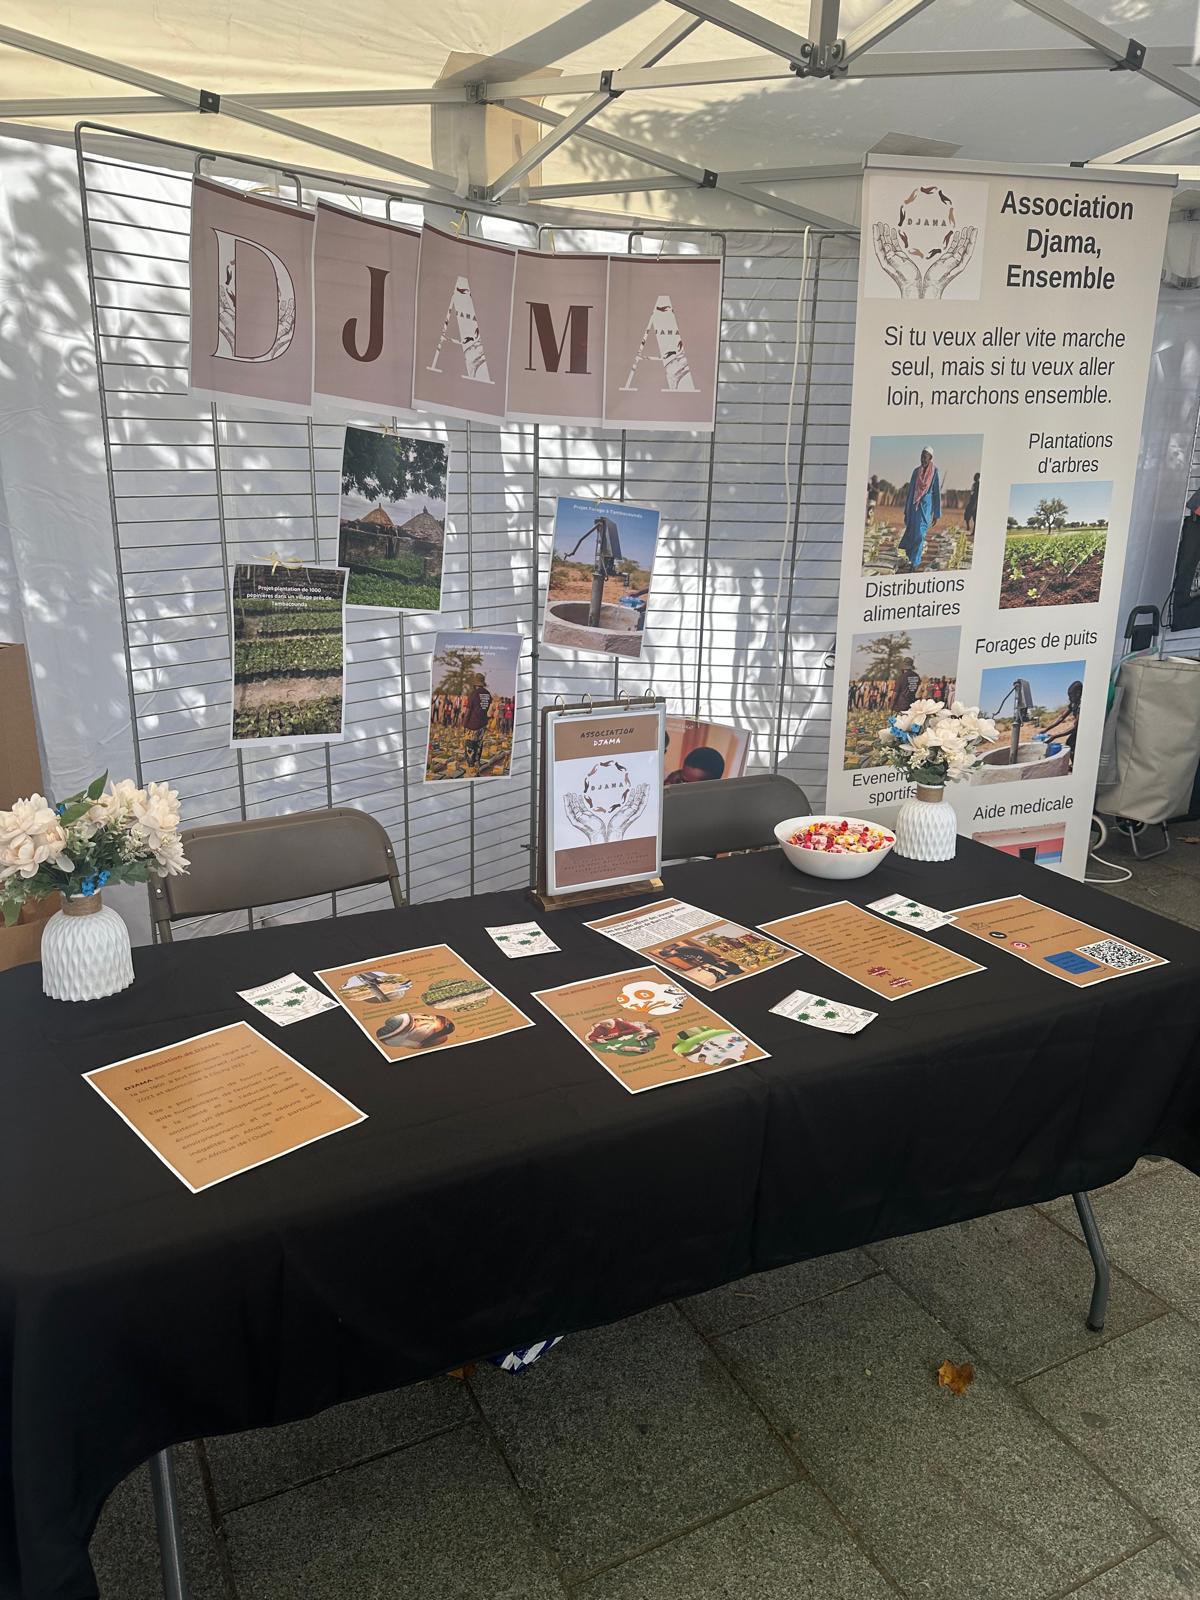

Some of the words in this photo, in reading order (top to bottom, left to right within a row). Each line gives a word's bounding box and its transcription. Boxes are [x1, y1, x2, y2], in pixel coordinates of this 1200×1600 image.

[1000, 190, 1134, 220] Association
[1026, 228, 1102, 258] Djama,
[1006, 264, 1115, 290] Ensemble
[884, 326, 903, 346] Si
[909, 327, 926, 346] tu
[933, 331, 976, 346] veux
[982, 327, 1020, 346] aller
[1026, 327, 1056, 347] vite
[1062, 328, 1126, 347] marche
[891, 356, 934, 379] seul,
[941, 356, 985, 376] mais
[990, 356, 1005, 376] si
[1011, 357, 1026, 376] tu
[1032, 360, 1074, 376] veux
[1079, 357, 1115, 376] aller
[887, 386, 924, 408] loin,
[931, 385, 1020, 405] marchons
[1024, 384, 1112, 404] ensemble.
[1029, 432, 1113, 449] Plantations
[1038, 456, 1099, 473] d'arbres
[865, 577, 965, 598] Distributions
[863, 600, 961, 622] alimentaires
[975, 636, 1036, 655] Forages
[1041, 632, 1060, 648] de
[1064, 629, 1098, 650] puits
[580, 728, 634, 738] ASSOCIATION
[593, 737, 621, 746] DJAMA
[973, 804, 1006, 820] Aide
[1010, 795, 1074, 815] medicale
